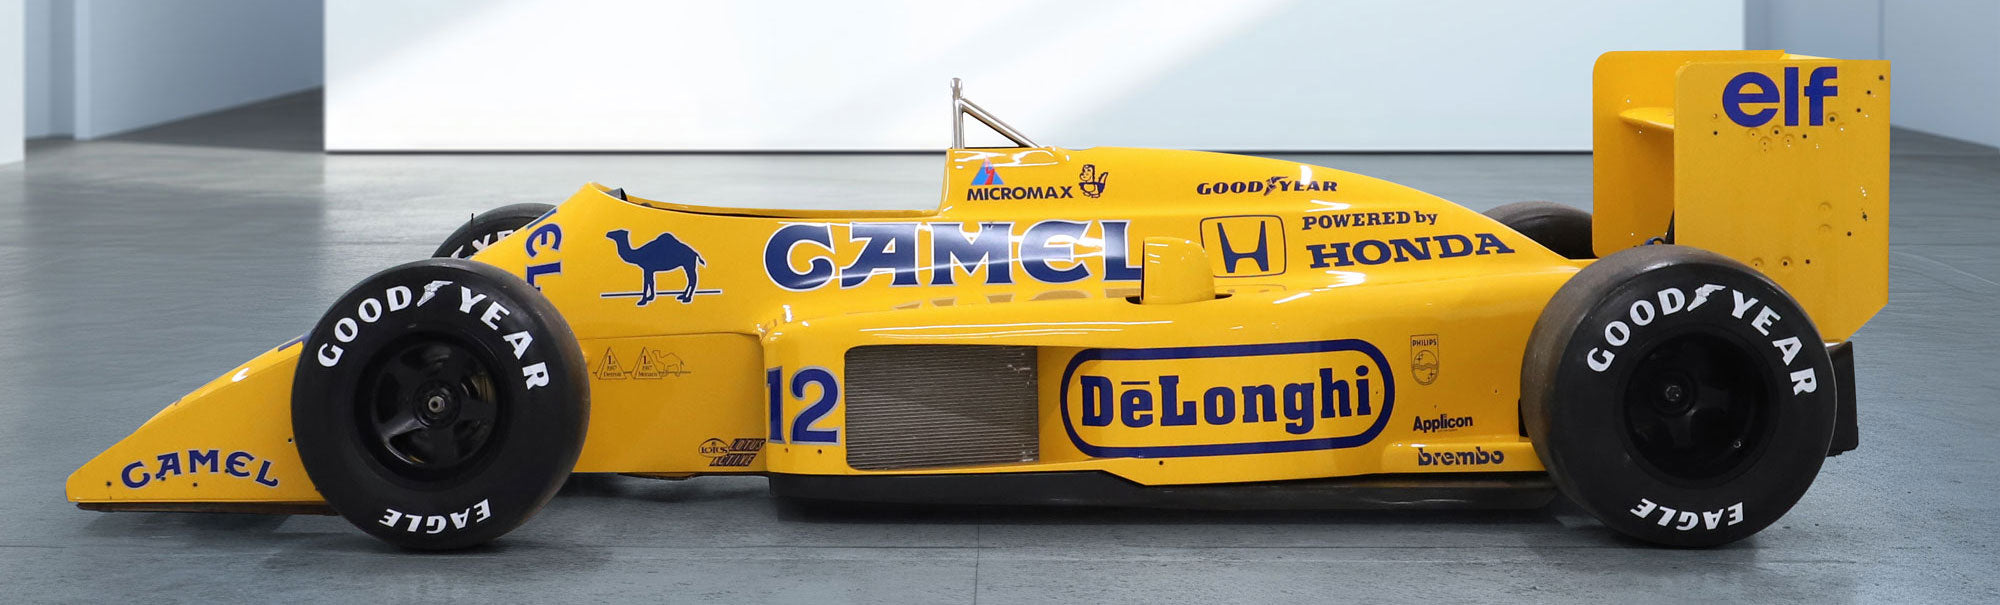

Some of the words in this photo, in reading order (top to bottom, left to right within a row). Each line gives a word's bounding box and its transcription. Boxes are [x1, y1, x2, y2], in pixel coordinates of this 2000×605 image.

[1722, 66, 1838, 128] elf
[967, 186, 1074, 201] MICROMAX
[1302, 211, 1411, 231] POWERED
[1415, 210, 1438, 226] by
[763, 220, 1142, 292] CAMEL
[1306, 233, 1515, 269] HONDA
[1412, 339, 1437, 347] PHILIPS
[766, 366, 840, 446] 12
[1413, 414, 1474, 433] Applicon
[121, 449, 279, 488] CAMEL
[1418, 446, 1505, 466] brembo
[378, 499, 492, 534] EAGLE
[1630, 498, 1744, 531] EAGLE
